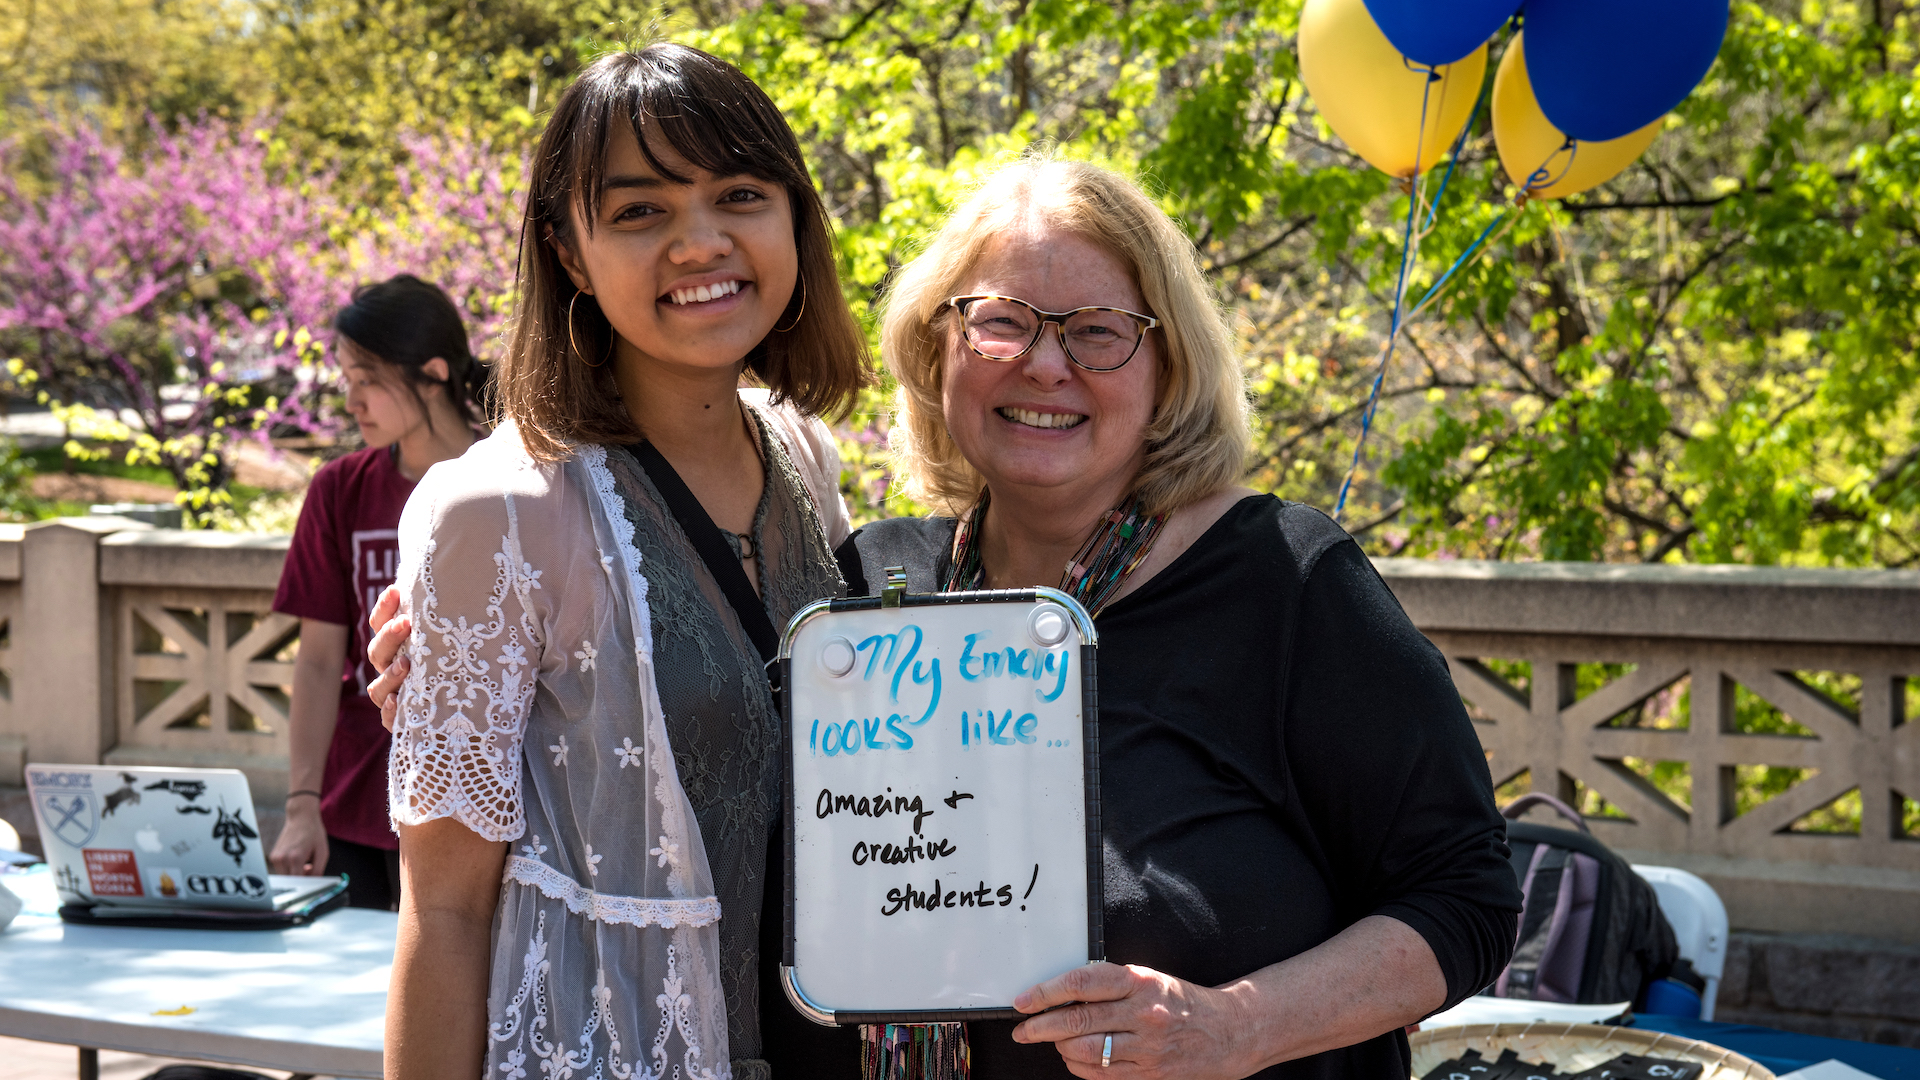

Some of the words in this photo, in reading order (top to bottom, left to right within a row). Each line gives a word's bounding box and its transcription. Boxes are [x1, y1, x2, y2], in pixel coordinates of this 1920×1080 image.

[856, 624, 942, 729] My
[959, 629, 1069, 703] Emory
[852, 834, 957, 866] creative
[86, 852, 130, 863] LIBERTY
[89, 863, 104, 872] IN
[91, 872, 135, 884] NORTH
[94, 882, 137, 893] KOREA
